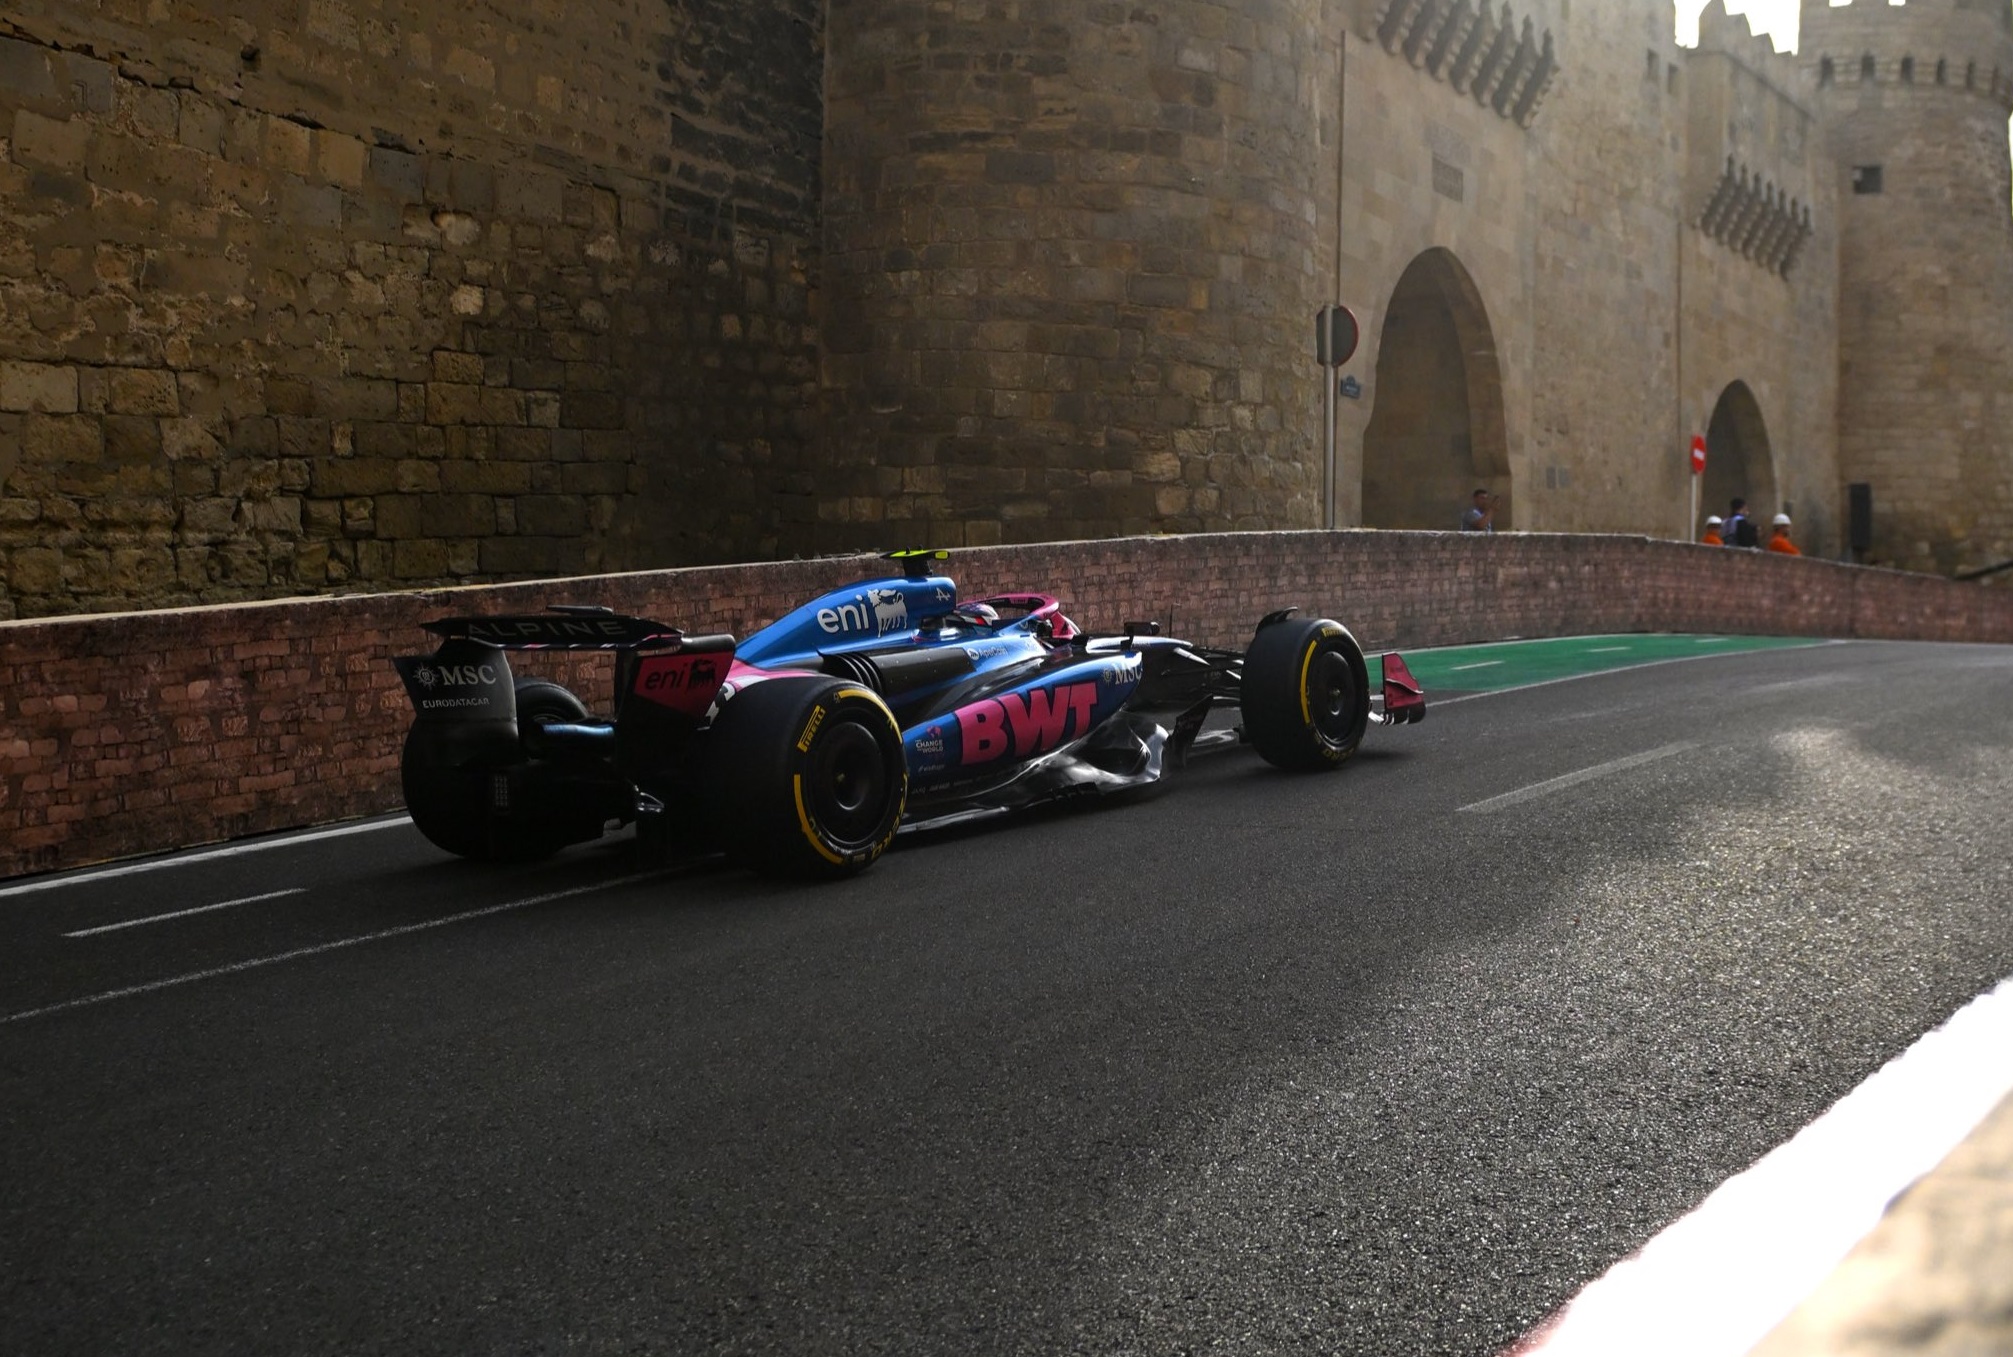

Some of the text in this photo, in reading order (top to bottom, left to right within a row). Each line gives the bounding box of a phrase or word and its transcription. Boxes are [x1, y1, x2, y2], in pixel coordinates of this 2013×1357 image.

[817, 594, 869, 634] eni
[468, 620, 627, 637] ALPINE
[437, 664, 497, 686] MSC
[645, 662, 688, 690] eni
[422, 697, 490, 709] EURODATACAR
[797, 705, 826, 752] PIRELLI
[954, 681, 1099, 766] BWT
[915, 739, 943, 749] CHANGE
